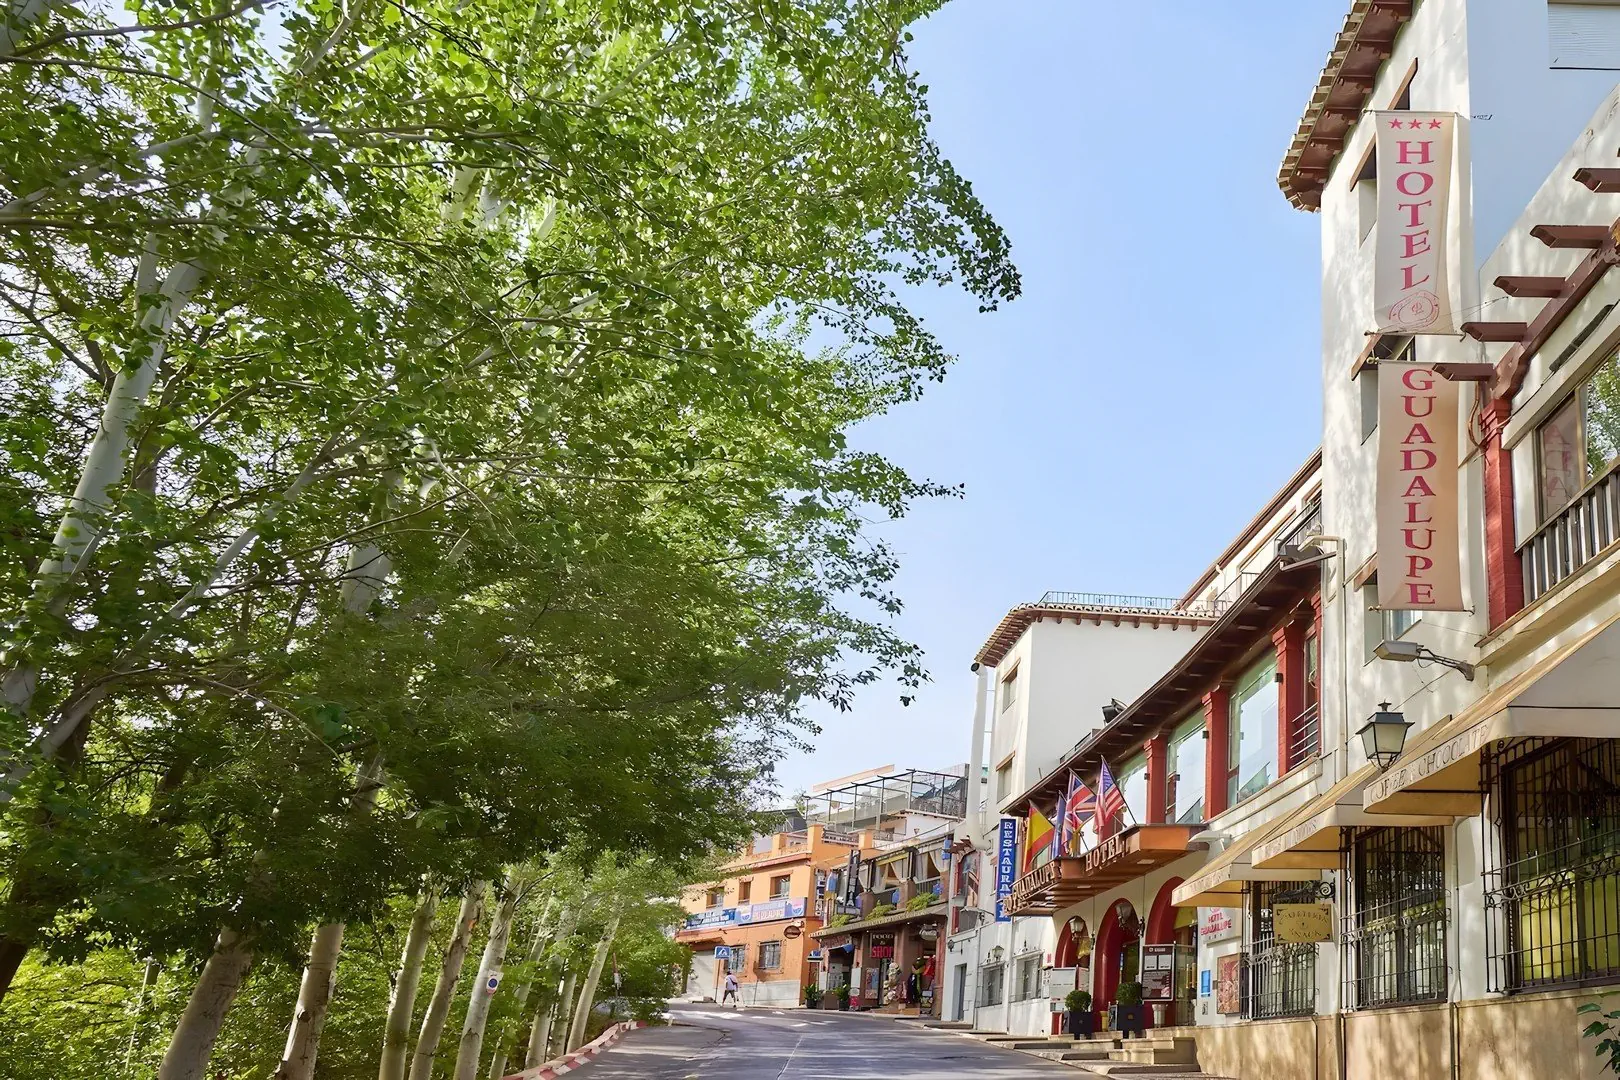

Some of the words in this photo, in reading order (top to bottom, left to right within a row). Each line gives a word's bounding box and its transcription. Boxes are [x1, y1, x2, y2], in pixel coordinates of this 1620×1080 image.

[1395, 139, 1436, 291] HOTEL
[1399, 367, 1437, 606] GUADALUPE
[998, 821, 1014, 918] RESTAURAN
[1085, 834, 1123, 872] HOTEL
[871, 945, 894, 959] SHOP
